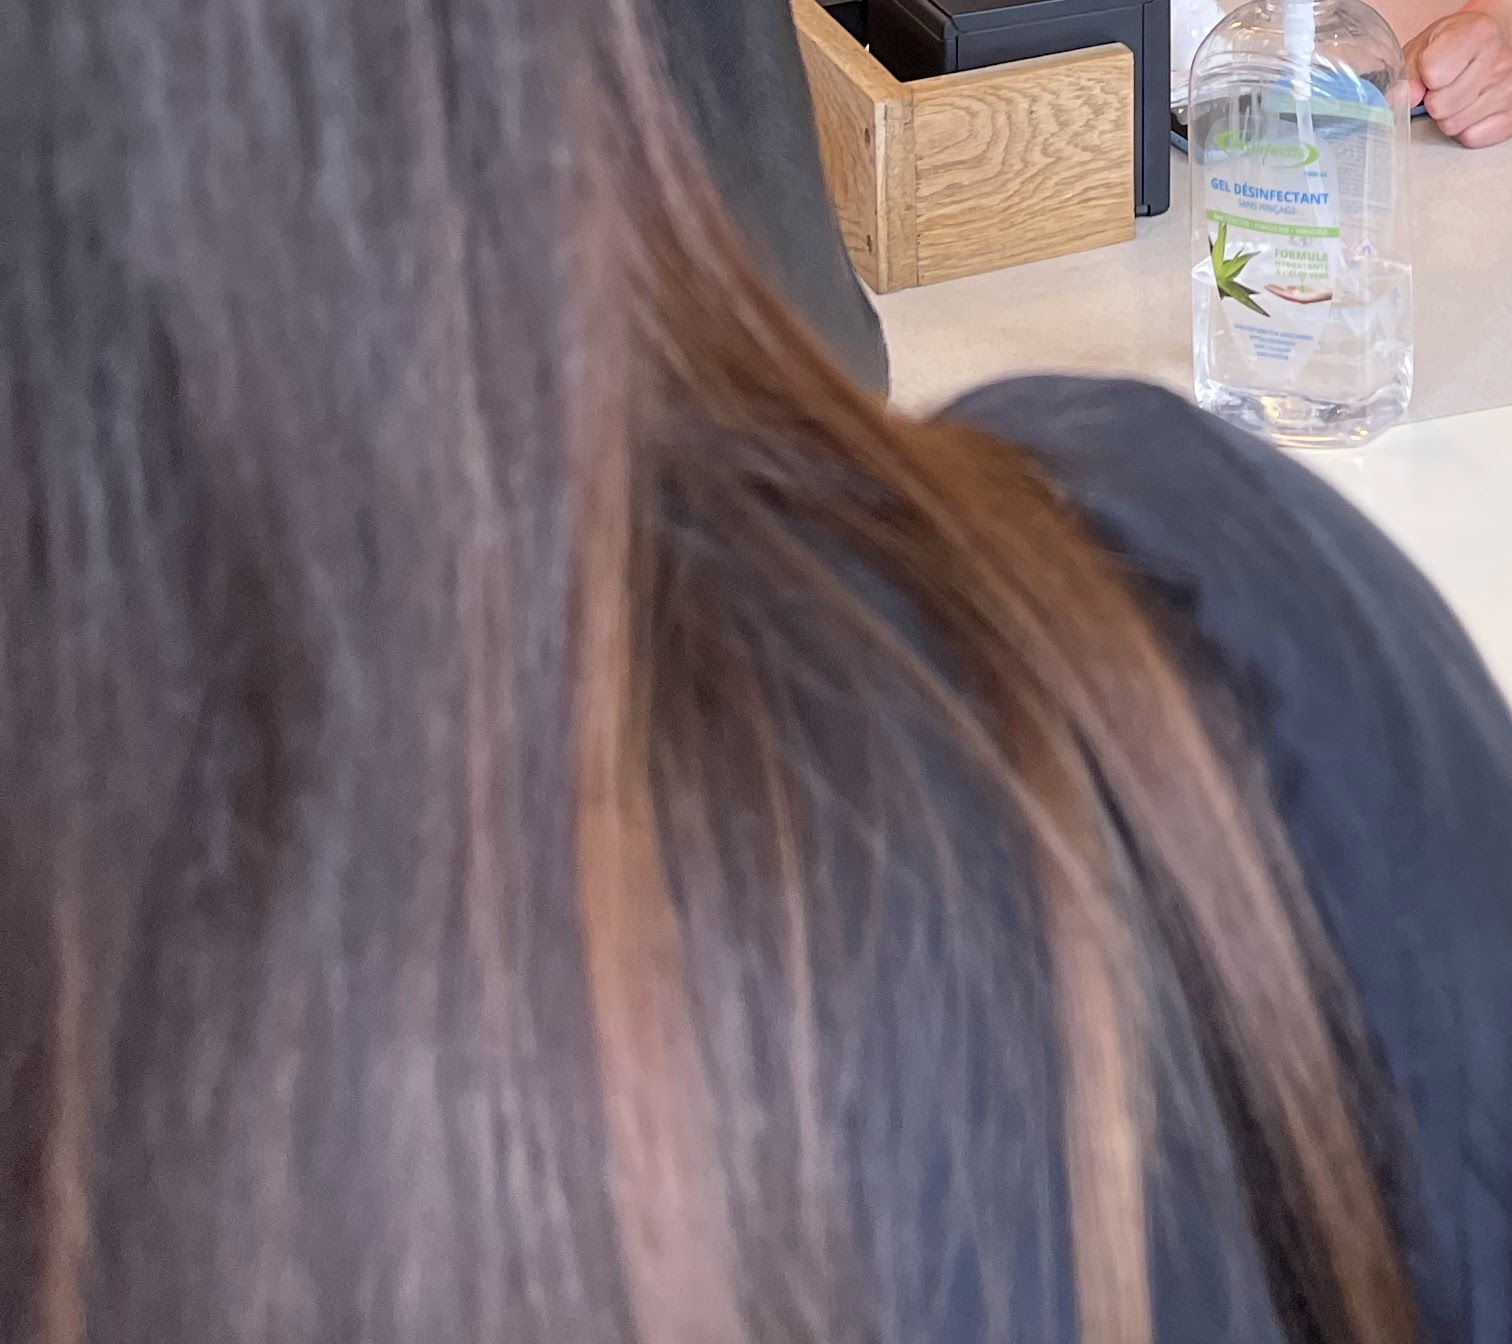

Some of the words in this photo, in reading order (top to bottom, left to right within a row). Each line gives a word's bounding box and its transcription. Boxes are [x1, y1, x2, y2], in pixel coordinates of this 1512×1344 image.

[1210, 177, 1231, 193] GEL
[1234, 182, 1329, 205] DÉSINFECTANT
[1274, 249, 1329, 262] FORMULE
